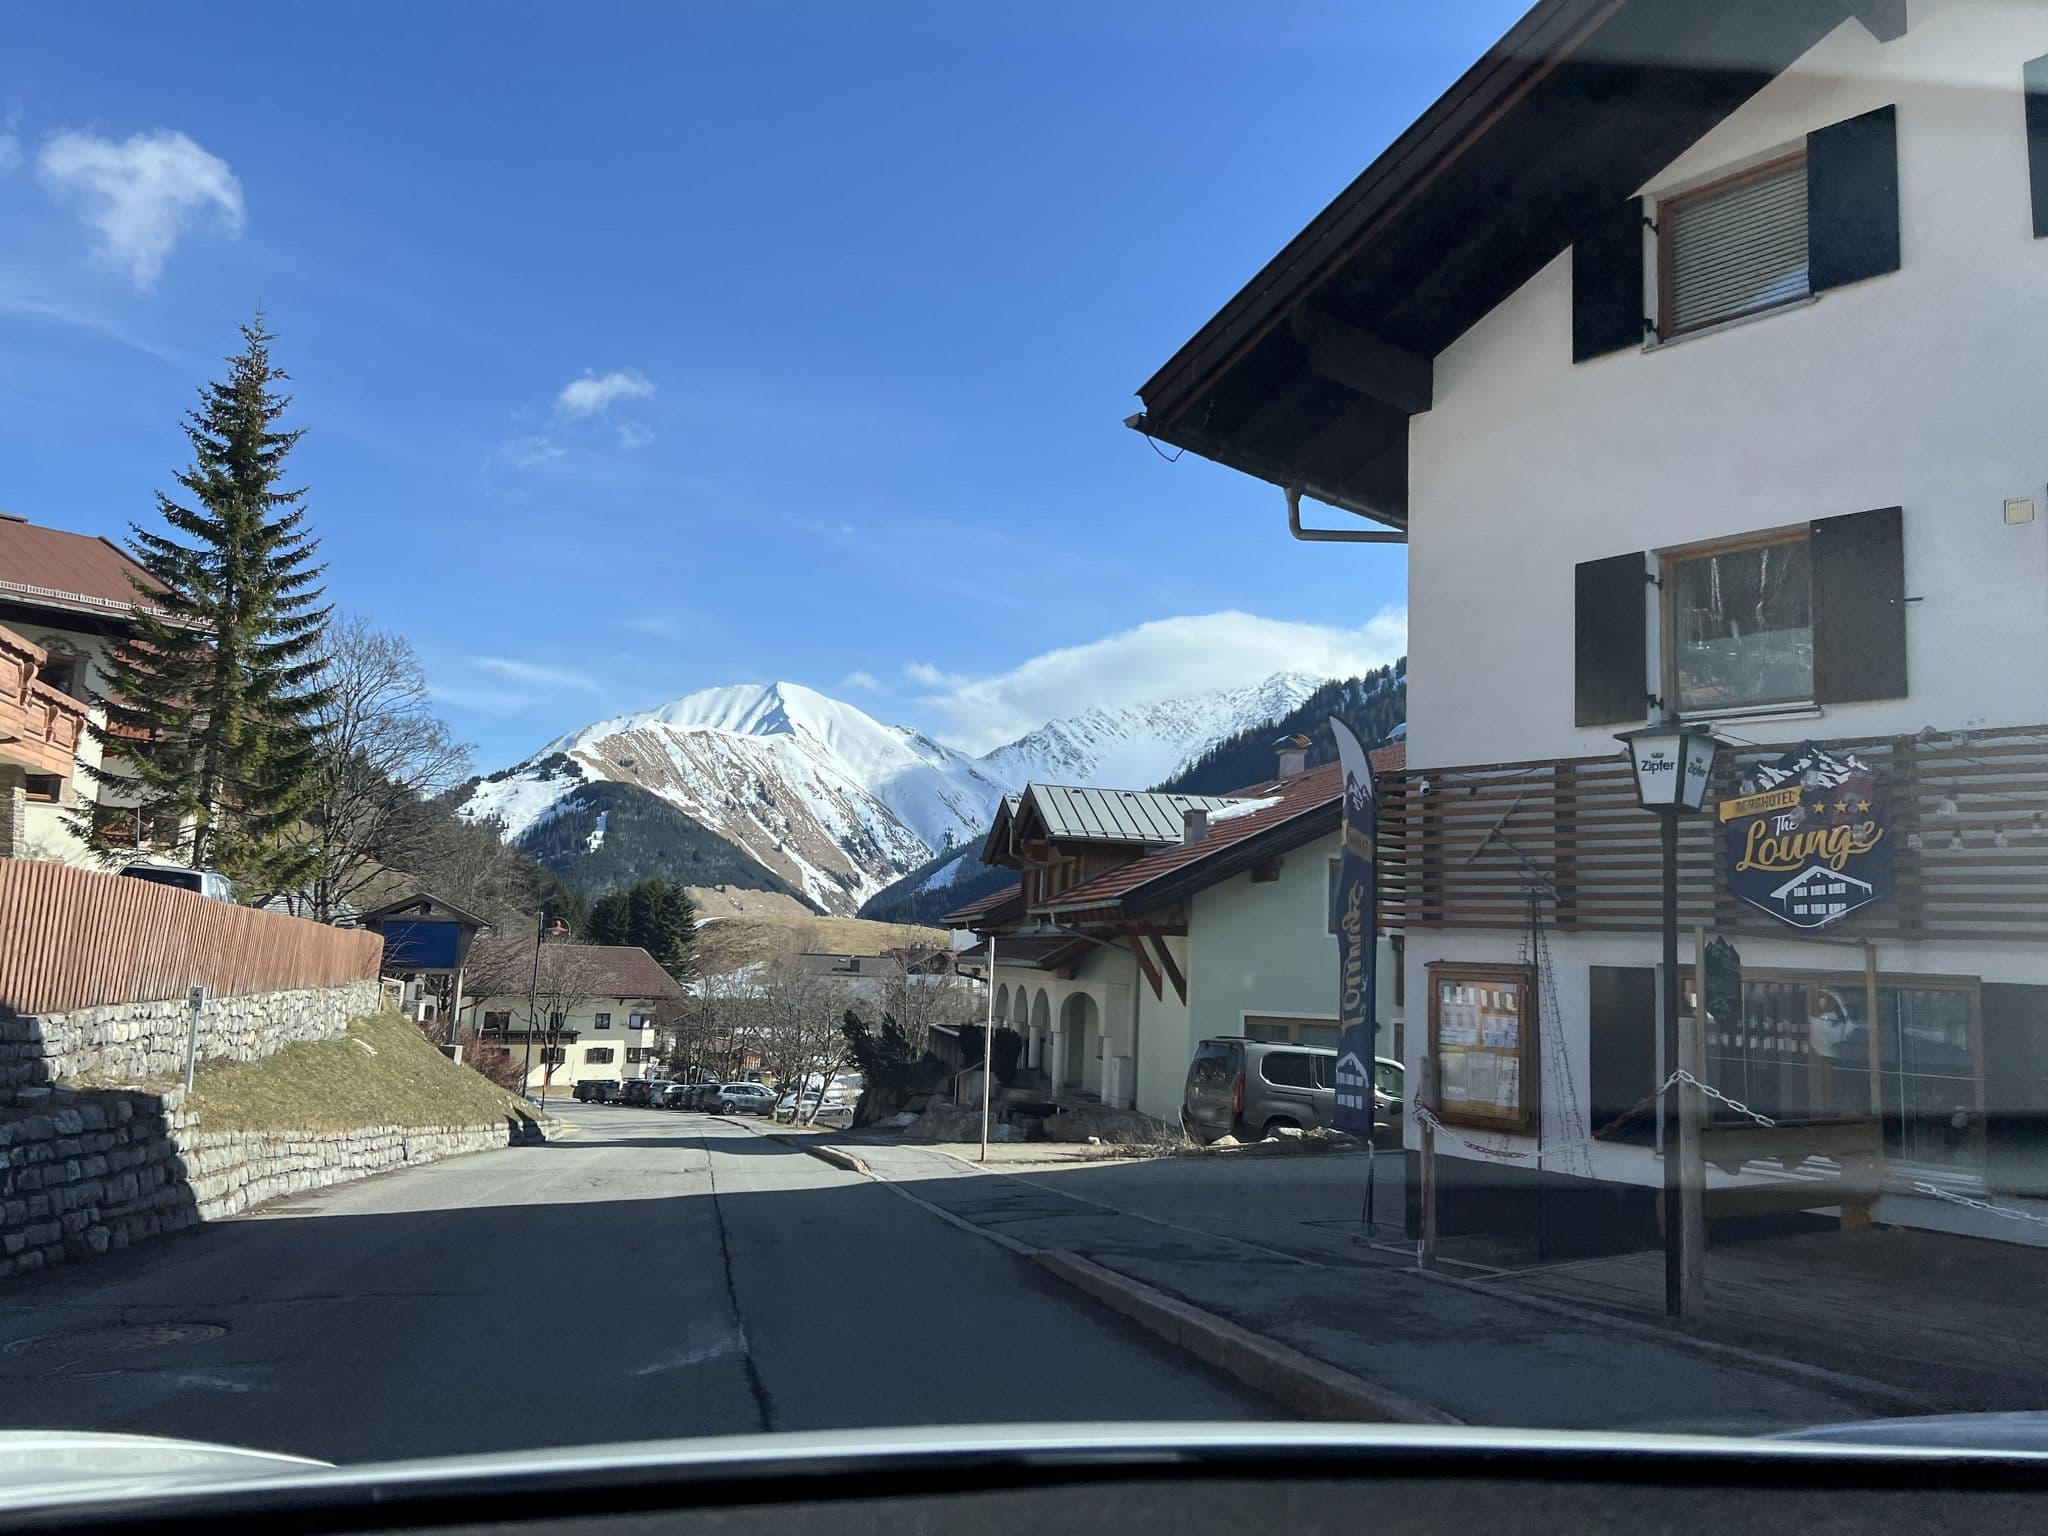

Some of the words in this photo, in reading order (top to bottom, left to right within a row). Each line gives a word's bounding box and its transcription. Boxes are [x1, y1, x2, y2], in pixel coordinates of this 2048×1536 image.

[1641, 759, 1675, 775] Zipfer
[1771, 814, 1800, 836] The
[1736, 820, 1884, 872] Lounge
